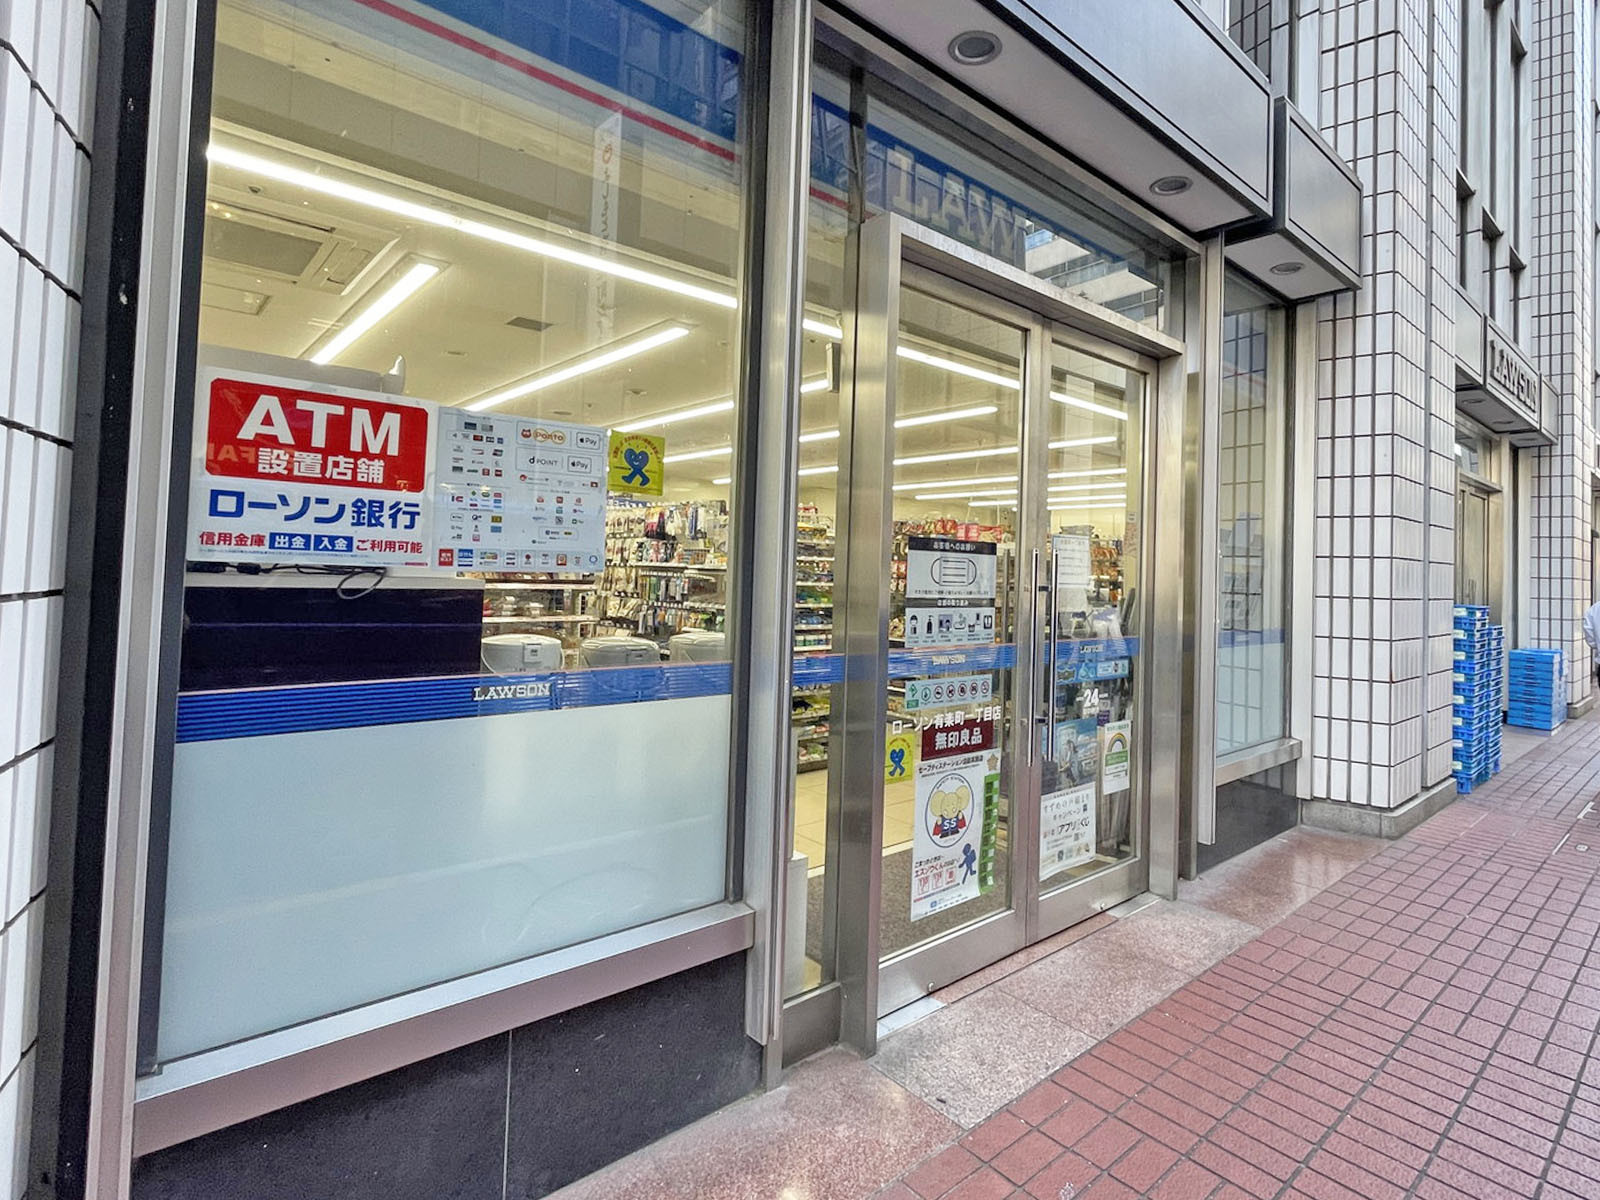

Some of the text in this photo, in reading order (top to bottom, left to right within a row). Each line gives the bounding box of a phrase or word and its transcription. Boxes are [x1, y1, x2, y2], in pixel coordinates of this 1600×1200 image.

[1489, 339, 1537, 414] LAWSON
[236, 393, 402, 457] ATM
[585, 436, 598, 447] Pay
[257, 447, 385, 484] 設置店舗
[576, 460, 589, 470] Pay
[208, 489, 421, 530] ローソン銀行
[199, 531, 266, 548] 信用金庫
[274, 533, 306, 549] 出金
[318, 536, 349, 551] 入金
[355, 538, 423, 554] ご利用可能
[473, 682, 551, 701] LAWSON
[1083, 688, 1099, 708] 24
[934, 727, 983, 751] 無印良品
[943, 818, 957, 830] SS
